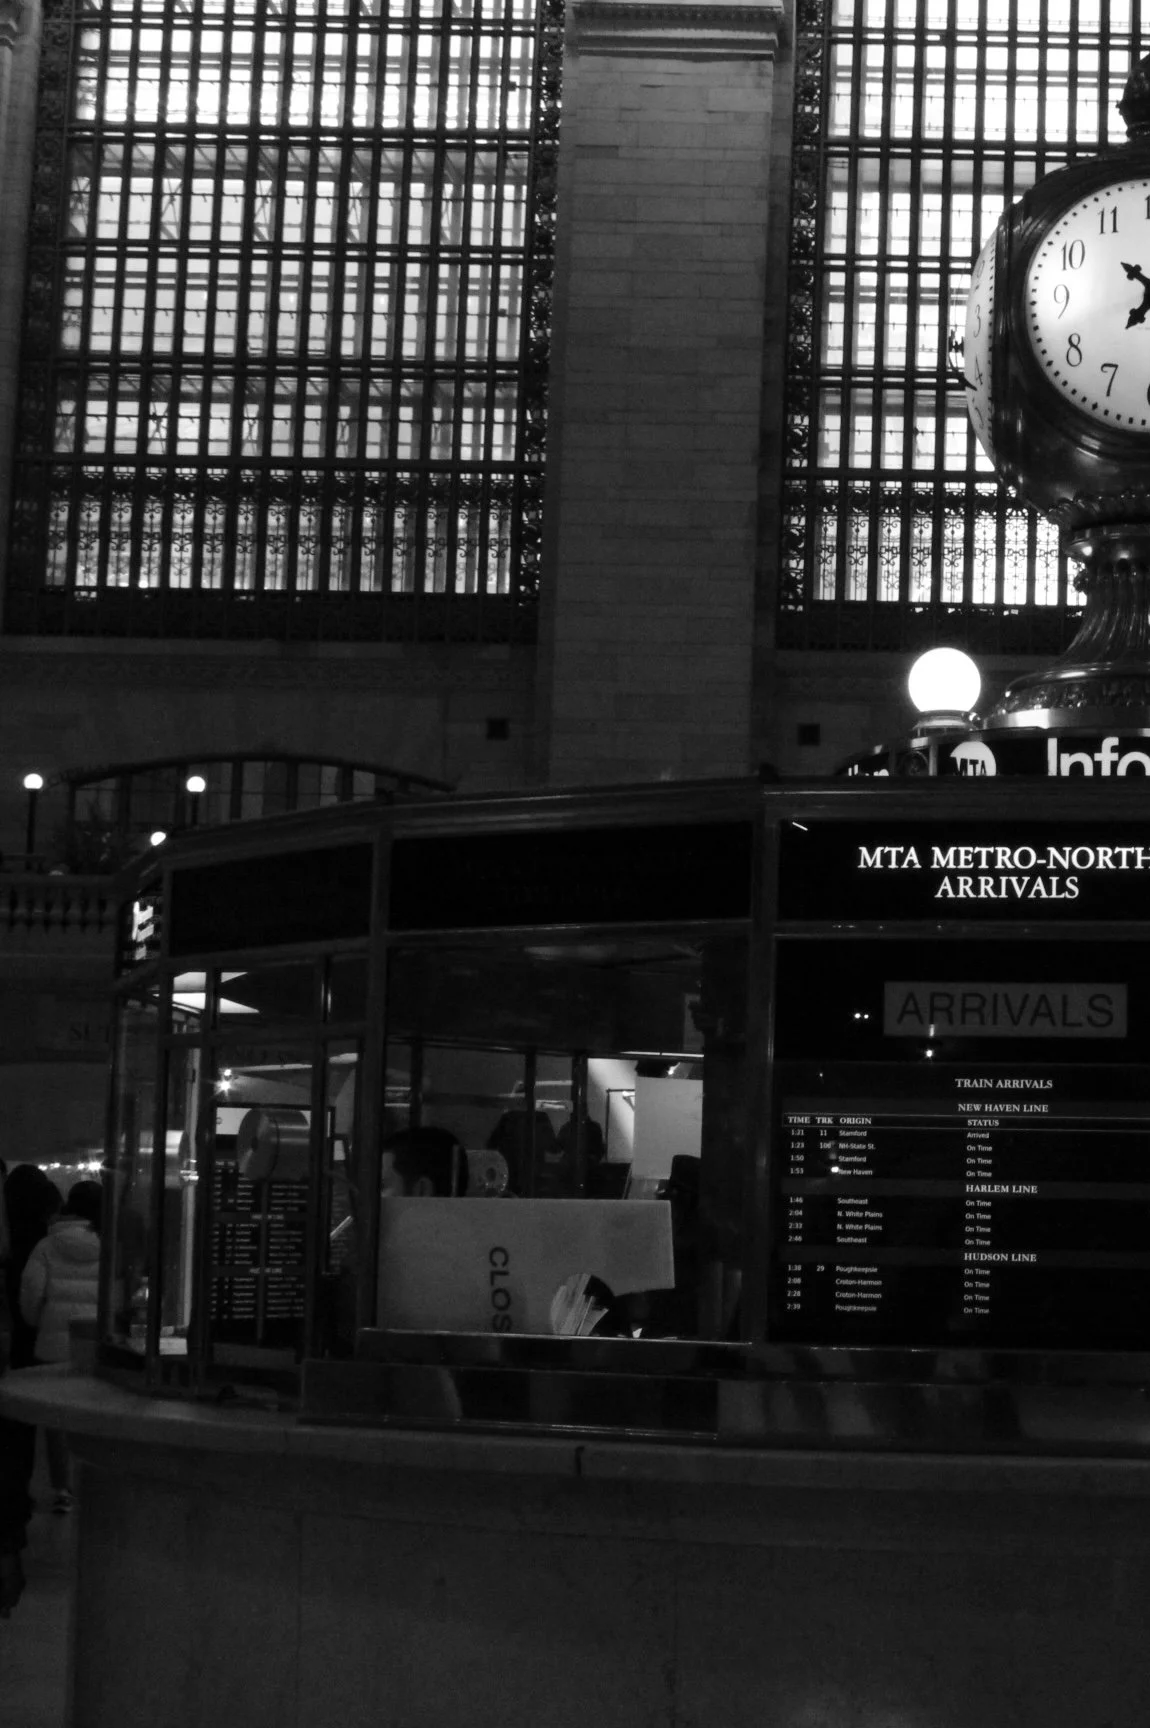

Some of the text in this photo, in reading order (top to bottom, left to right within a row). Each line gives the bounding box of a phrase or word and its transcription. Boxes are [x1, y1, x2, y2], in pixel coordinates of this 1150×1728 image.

[1098, 206, 1119, 234] 11
[1062, 240, 1085, 270] 10
[1053, 284, 1070, 319] 9
[1066, 333, 1083, 366] 8
[1101, 363, 1118, 396] 7
[858, 847, 921, 868] MTA
[935, 876, 1079, 898] ARRIVALS
[896, 991, 1115, 1029] ARRIVALS
[954, 1078, 1053, 1089] TRAIN ARRIVALS
[958, 1103, 1049, 1113] NEW HAVEN LINE
[788, 1116, 999, 1127] TIME TRK ORIGIN STATUS
[977, 1144, 992, 1152] Time
[977, 1157, 992, 1165] Time
[977, 1170, 992, 1178] Time
[965, 1184, 1038, 1194] HARLEM LINE
[964, 1253, 1037, 1263] HUDSON LINE
[976, 1268, 991, 1276] Time
